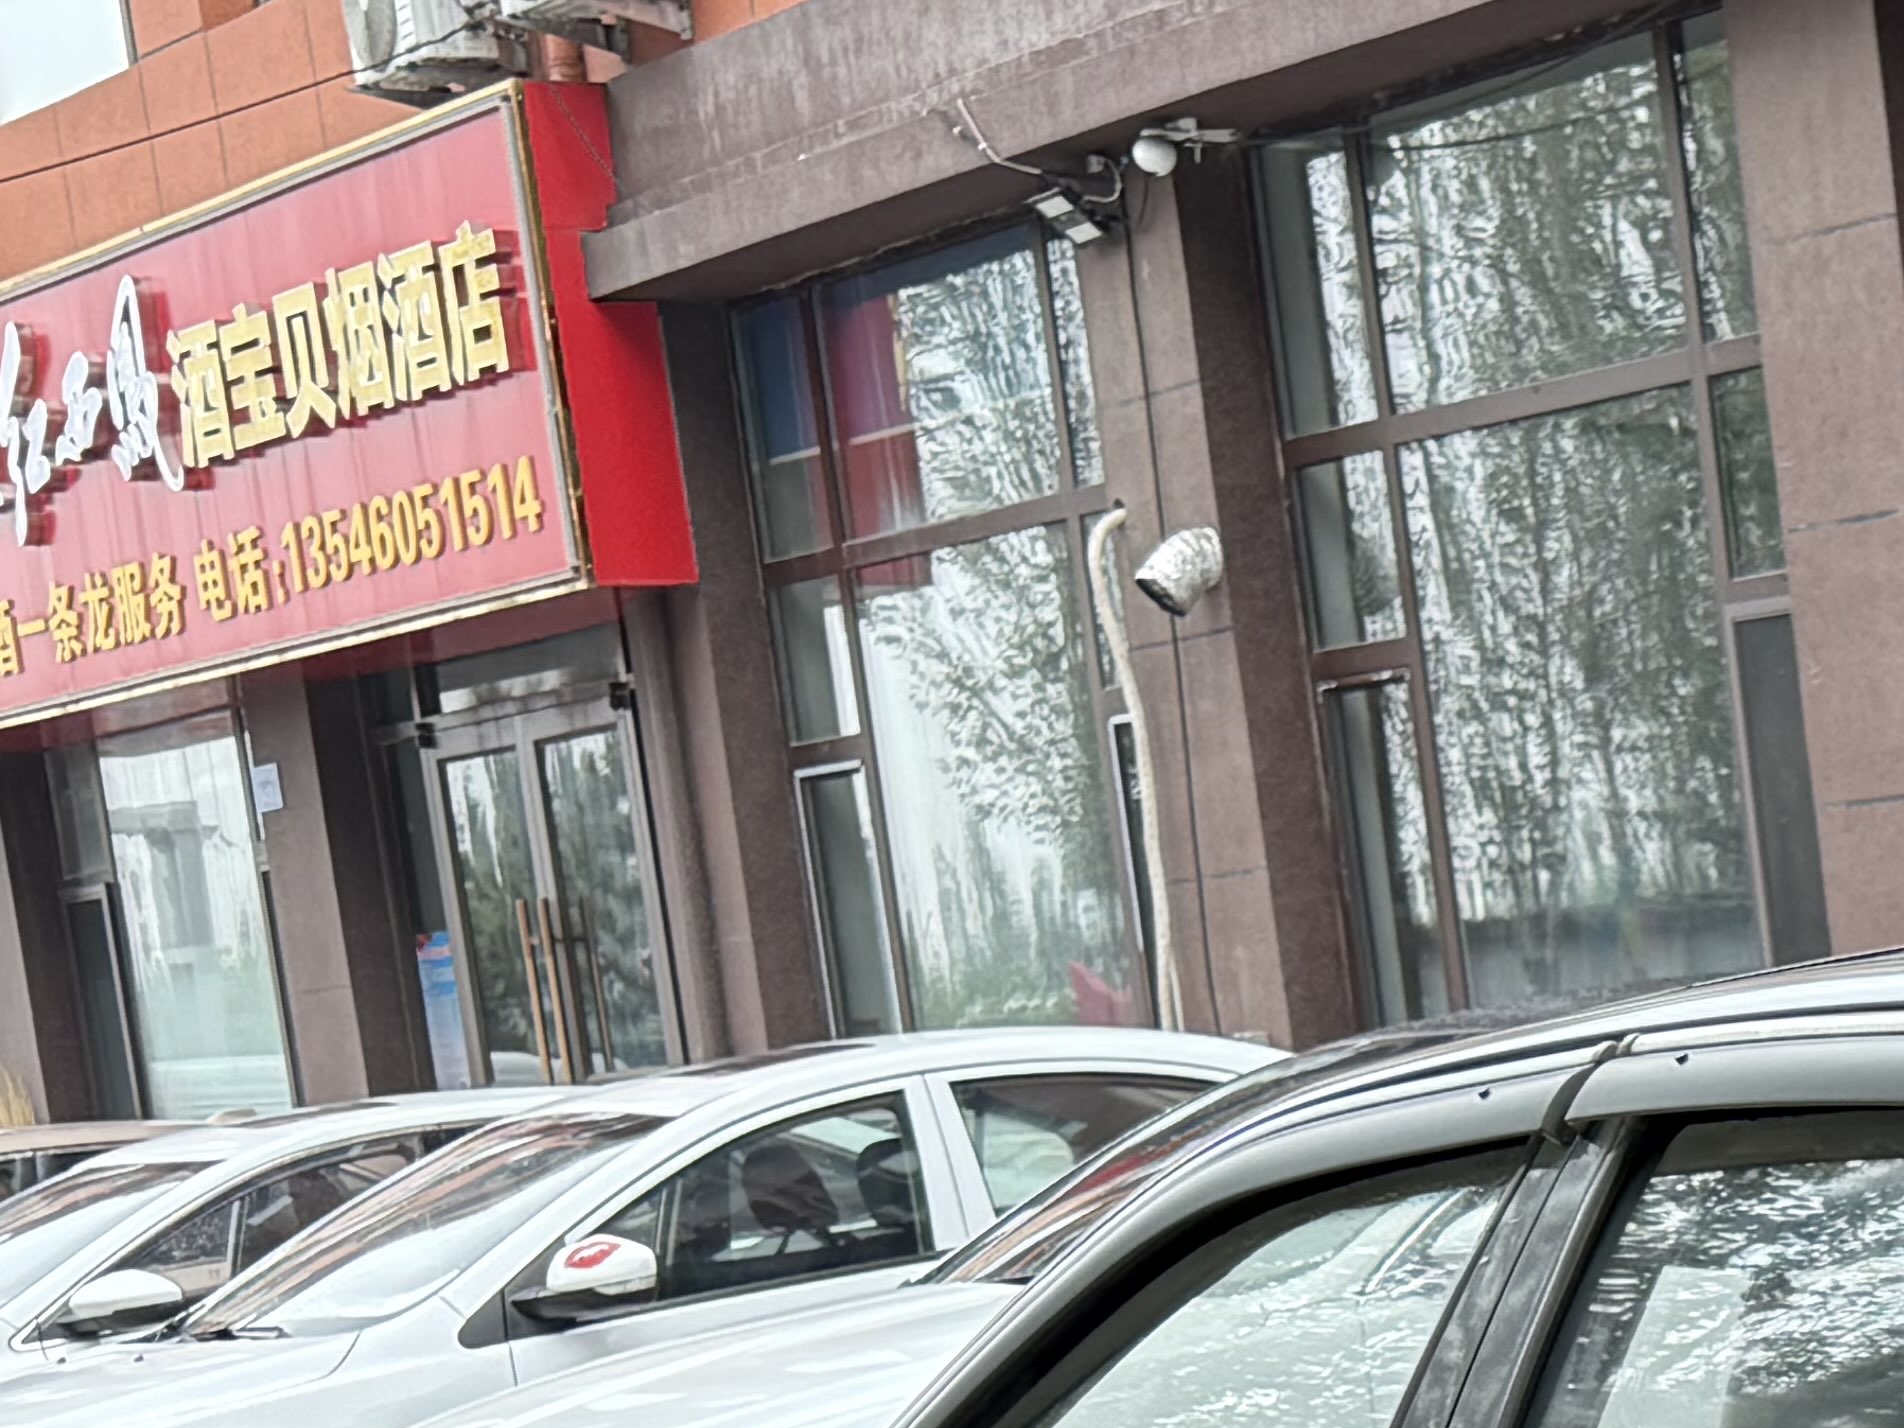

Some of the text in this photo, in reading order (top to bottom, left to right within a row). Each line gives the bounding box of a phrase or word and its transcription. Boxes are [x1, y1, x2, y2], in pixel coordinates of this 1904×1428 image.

[166, 220, 509, 468] 酒宝贝烟酒店
